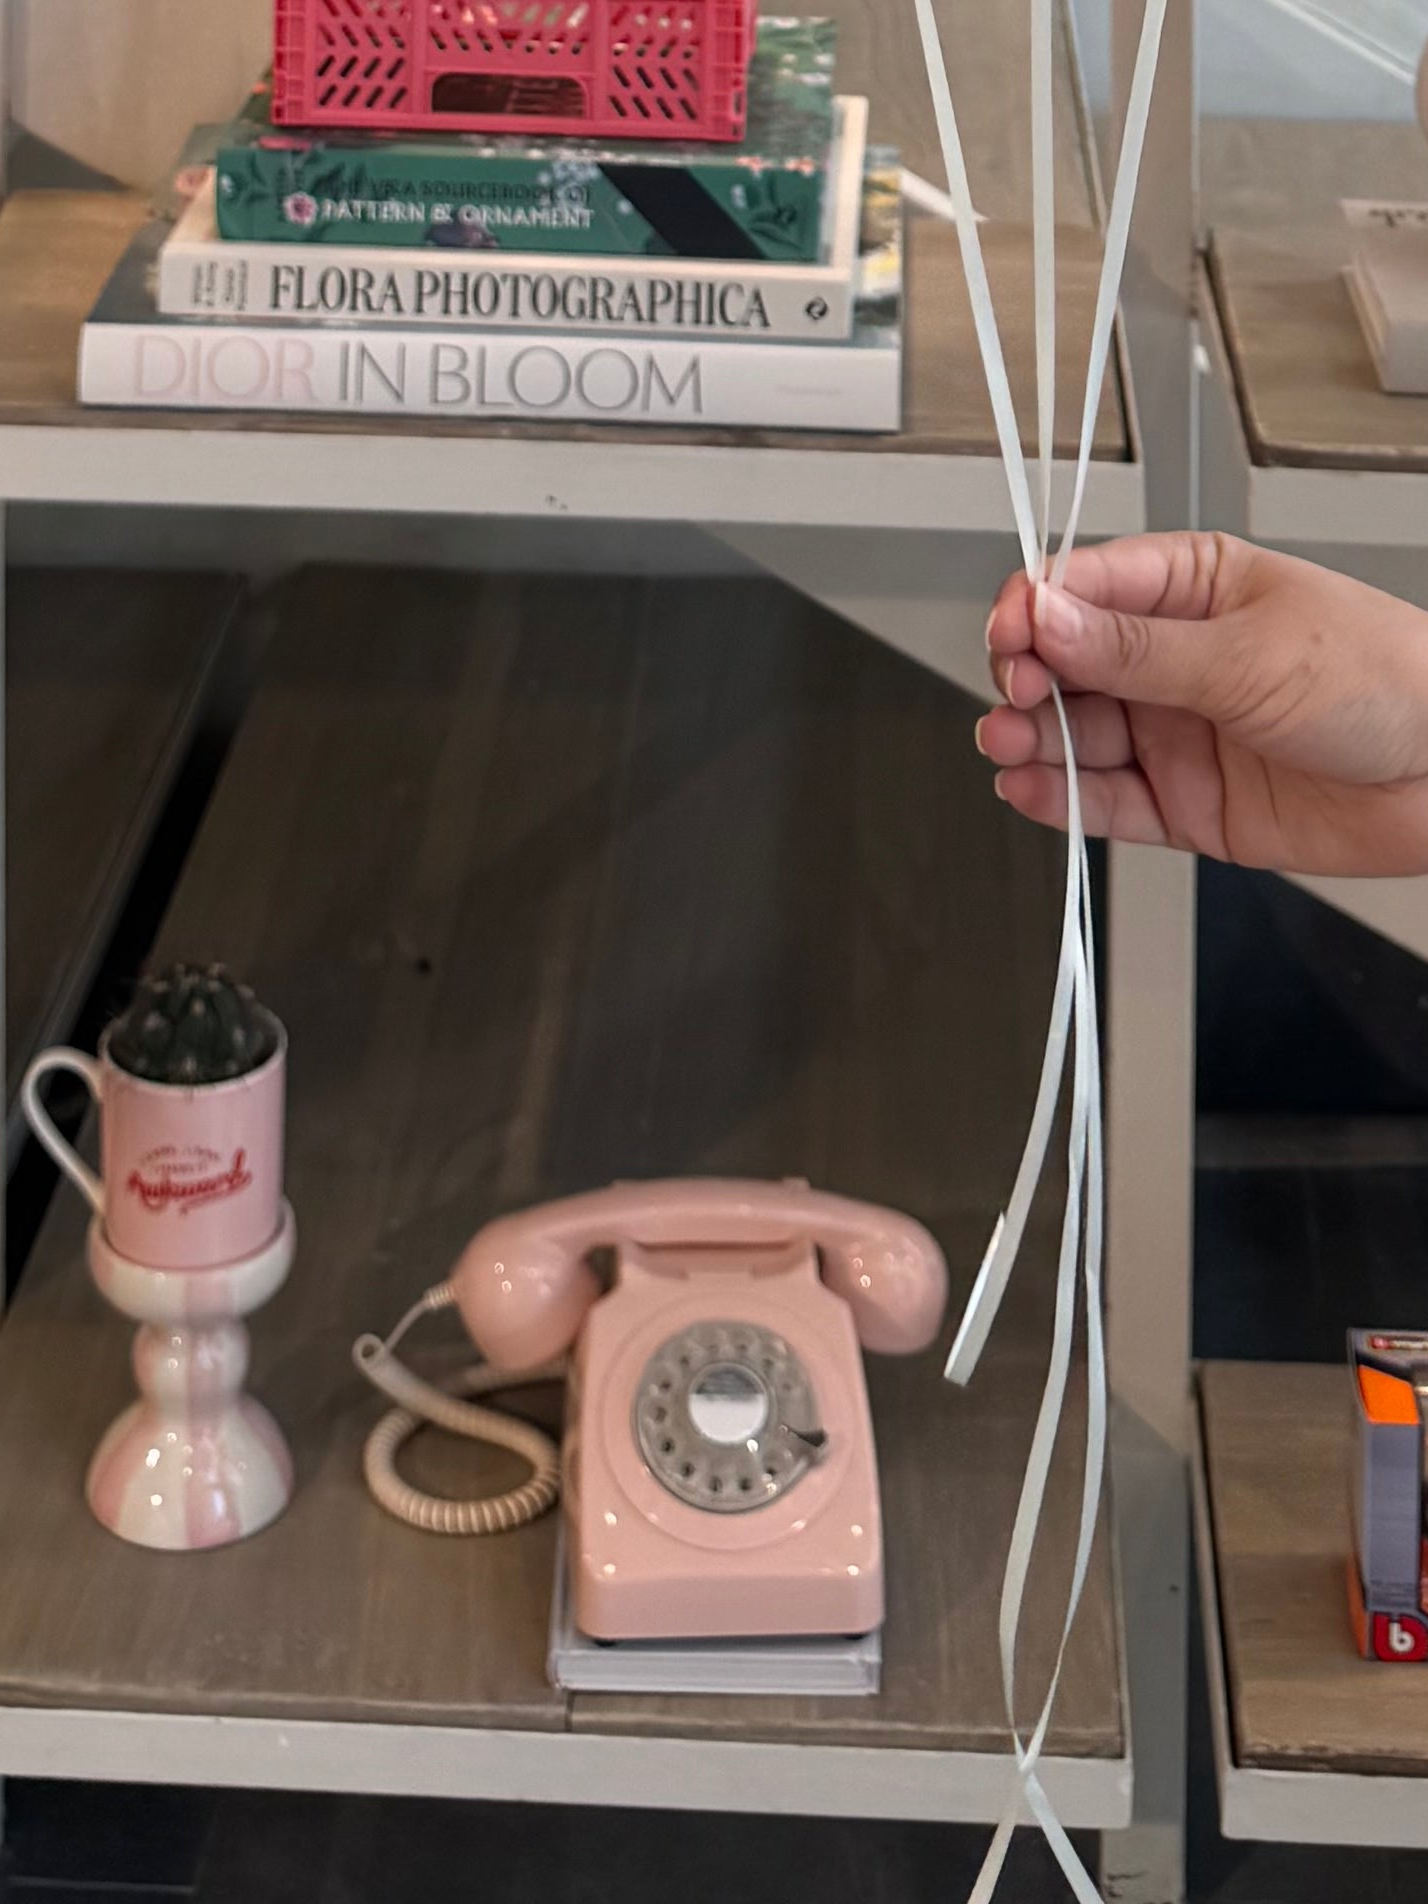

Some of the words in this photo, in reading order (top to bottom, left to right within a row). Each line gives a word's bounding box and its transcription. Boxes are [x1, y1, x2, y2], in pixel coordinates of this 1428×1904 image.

[321, 197, 426, 223] PATTERN
[430, 203, 452, 223] &
[457, 203, 594, 230] ORNAMENT
[270, 264, 404, 315] FLORA
[414, 269, 772, 328] PHOTOGRAPHICA
[132, 335, 316, 404] DIOR
[338, 340, 407, 406] IN
[429, 342, 704, 415] BLOOM
